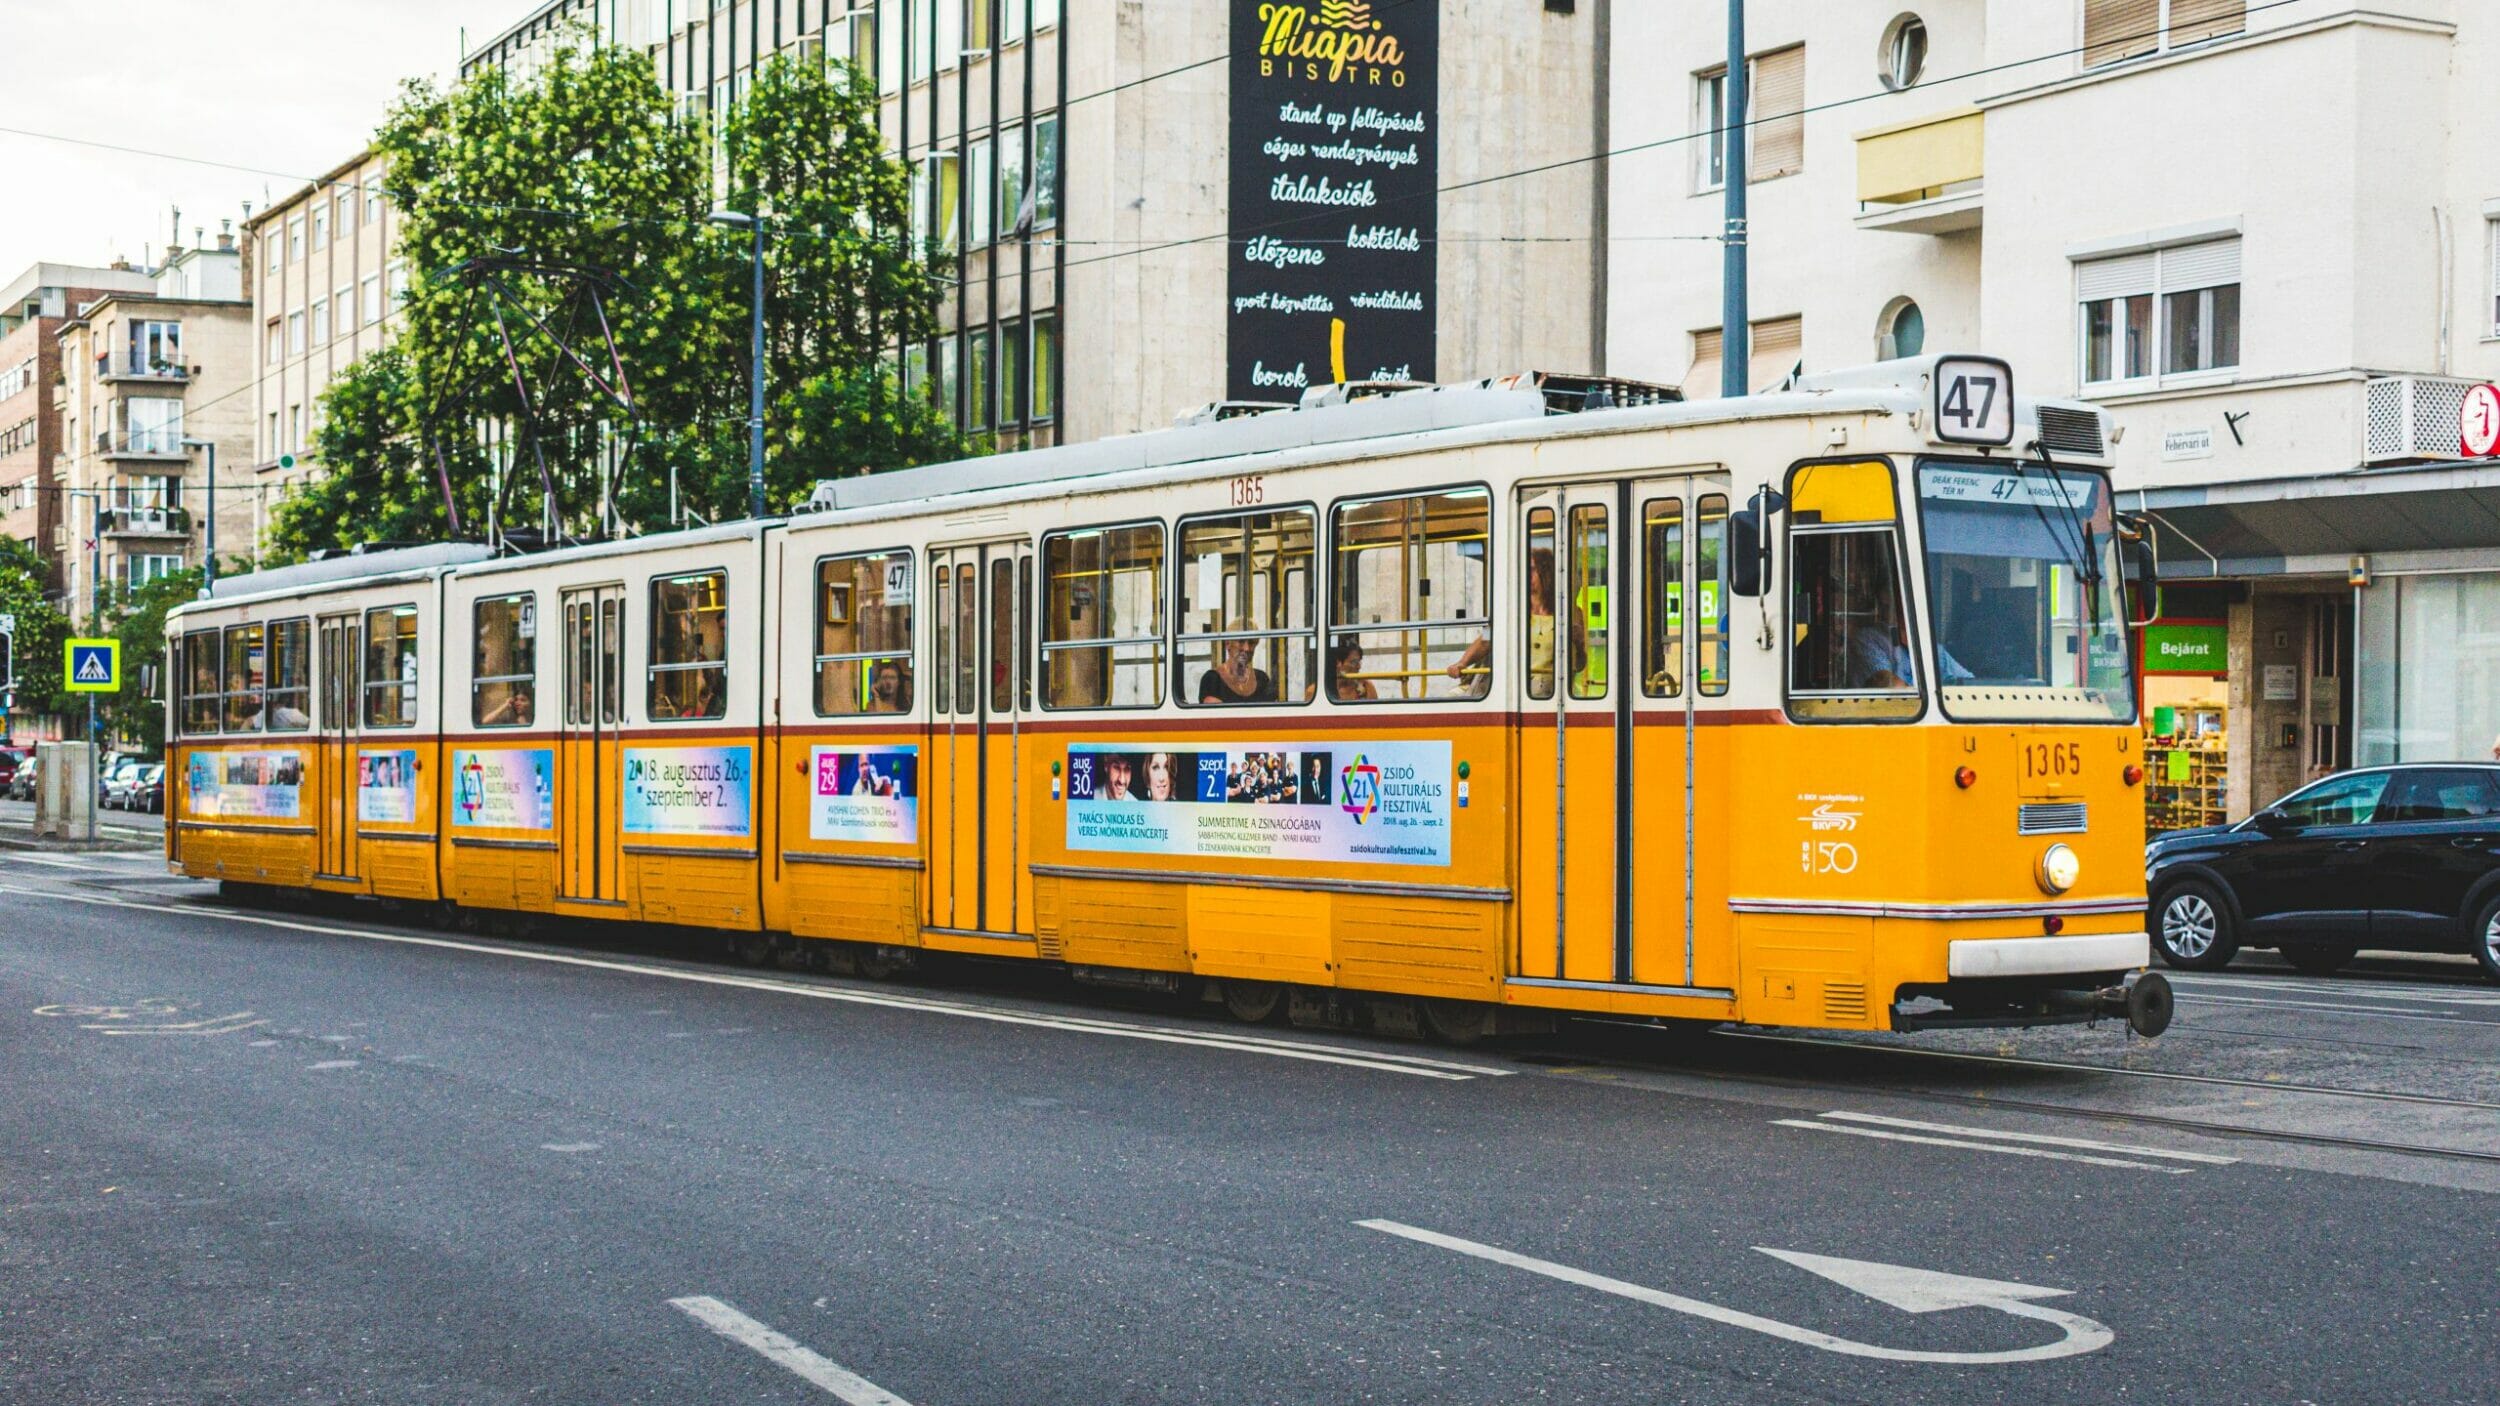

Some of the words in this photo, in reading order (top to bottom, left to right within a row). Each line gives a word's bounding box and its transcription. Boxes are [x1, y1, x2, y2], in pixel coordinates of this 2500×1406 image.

[1259, 3, 1404, 82] Miapia
[1260, 59, 1405, 87] BISTRO
[1280, 101, 1323, 125] stand
[1326, 113, 1346, 134] up
[1351, 107, 1426, 137] fellépések
[1263, 137, 1306, 162] céges
[1311, 139, 1419, 170] rendezvények
[1271, 173, 1377, 207] italakciók
[1347, 224, 1420, 251] koktélok
[1245, 235, 1326, 269] élőzene
[1234, 291, 1270, 314] sport
[1252, 361, 1308, 387] borok
[1370, 363, 1412, 383] sörök
[1942, 375, 1997, 429] 47
[1231, 477, 1263, 506] 1365
[1991, 478, 2018, 499] 47
[888, 566, 905, 590] 47
[2161, 642, 2209, 657] Bejárat
[1073, 758, 1092, 773] aug.
[1199, 759, 1226, 774] szept.
[2026, 742, 2080, 778] 1365
[629, 760, 660, 781] 218.
[664, 764, 721, 788] augusztus
[725, 759, 743, 781] 26.
[821, 772, 838, 791] 29.
[1383, 764, 1414, 780] ZSIDÓ
[1072, 773, 1093, 795] 30.
[1206, 775, 1220, 797] 2.
[1383, 781, 1442, 797] KULTURÁLIS
[646, 785, 713, 812] szeptember
[717, 785, 727, 807] 2.
[1383, 798, 1432, 813] FESZTIVÁL
[1078, 811, 1104, 824] TAKÁCS
[1105, 813, 1135, 825] NIKOLAS
[1137, 812, 1145, 825] ÉS
[1198, 817, 1248, 829] SUMMERTIME
[1251, 818, 1257, 829] A
[1258, 817, 1321, 830] ZSINAGÓGÁBAN
[1078, 826, 1098, 837] VERES
[1100, 825, 1128, 838] MÓNIKA
[1130, 828, 1169, 841] KONCERTJE
[1350, 844, 1437, 856] zsidokulturalisfesztival.hu
[1802, 842, 1810, 873] BKV
[1819, 842, 1858, 874] 50
